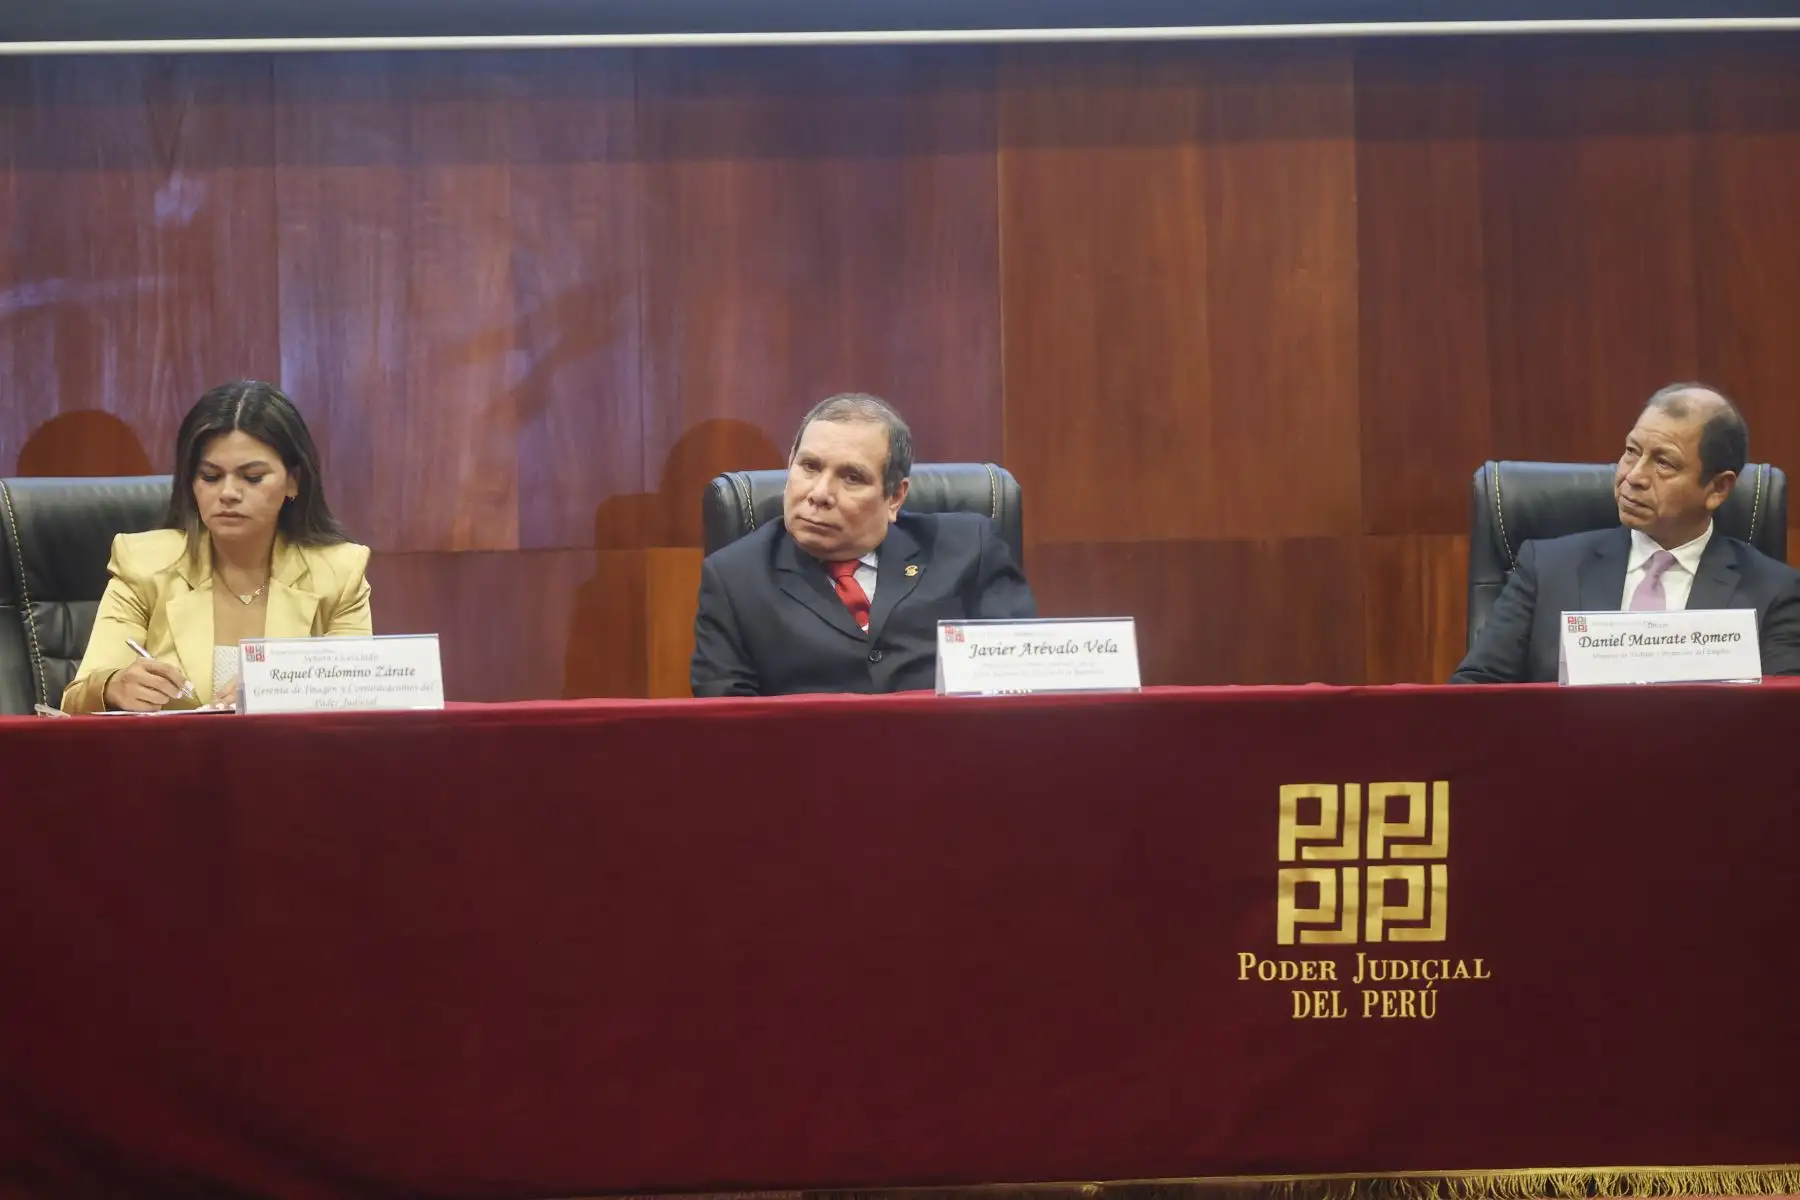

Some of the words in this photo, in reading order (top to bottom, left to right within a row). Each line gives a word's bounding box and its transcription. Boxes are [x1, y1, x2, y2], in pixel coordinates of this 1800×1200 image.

[968, 642, 1017, 659] Javier
[1018, 639, 1079, 657] Arévalo
[1083, 638, 1119, 654] Vela
[1579, 633, 1624, 648] Daniel
[1628, 633, 1687, 647] Maurate
[1690, 631, 1741, 645] Romero
[269, 665, 312, 683] Raquel
[314, 664, 371, 679] Palomino
[375, 664, 416, 678] Zárate
[1237, 952, 1338, 981] PODER
[1352, 952, 1491, 984] JUDICIAL
[1291, 990, 1347, 1019] DEL
[1361, 981, 1438, 1019] PERÚ
